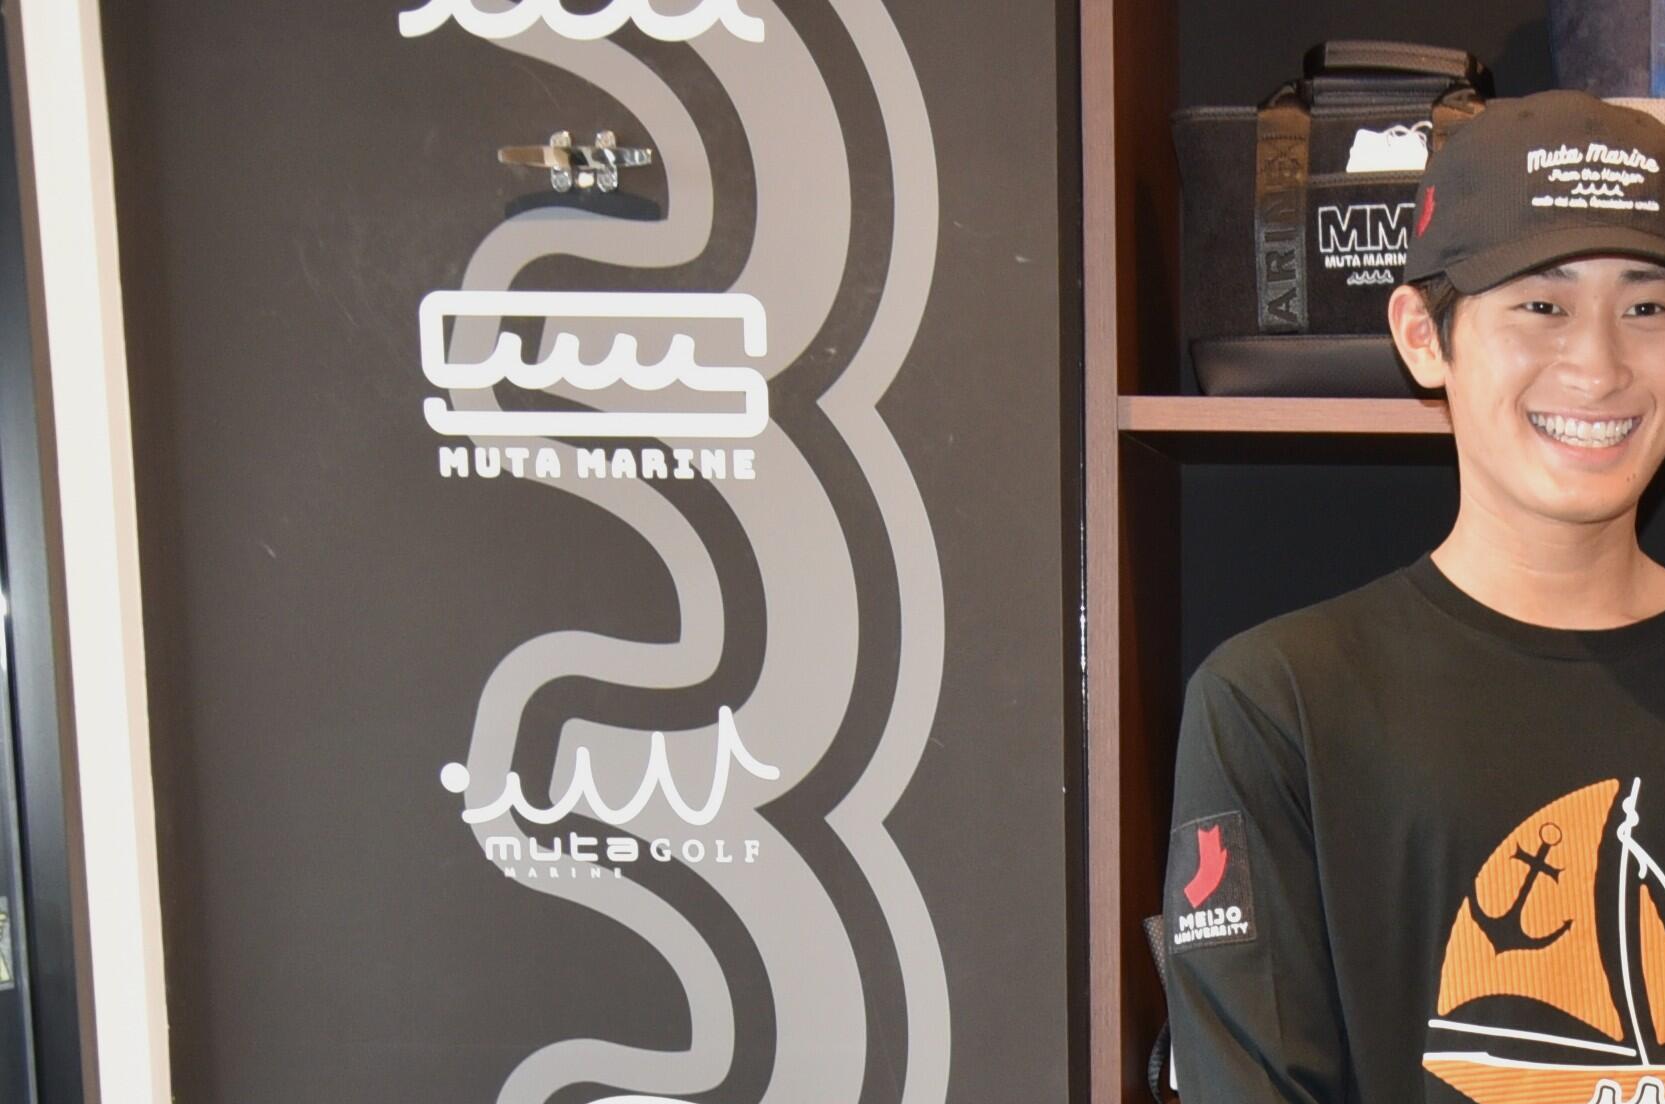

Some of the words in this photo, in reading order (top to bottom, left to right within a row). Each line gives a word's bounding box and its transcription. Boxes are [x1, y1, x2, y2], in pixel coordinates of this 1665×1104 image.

[1527, 144, 1583, 174] Muta
[1586, 143, 1660, 173] Marine
[1318, 203, 1416, 253] MM
[1325, 254, 1360, 268] MUTA
[1363, 253, 1407, 266] MARIN
[439, 446, 561, 478] MUTA
[576, 448, 756, 479] MARINE
[485, 832, 639, 862] muta
[650, 838, 760, 863] GOLF
[504, 867, 622, 878] MARINE
[1179, 906, 1242, 931] MEIJO
[1174, 921, 1248, 945] UNIVERSITY
